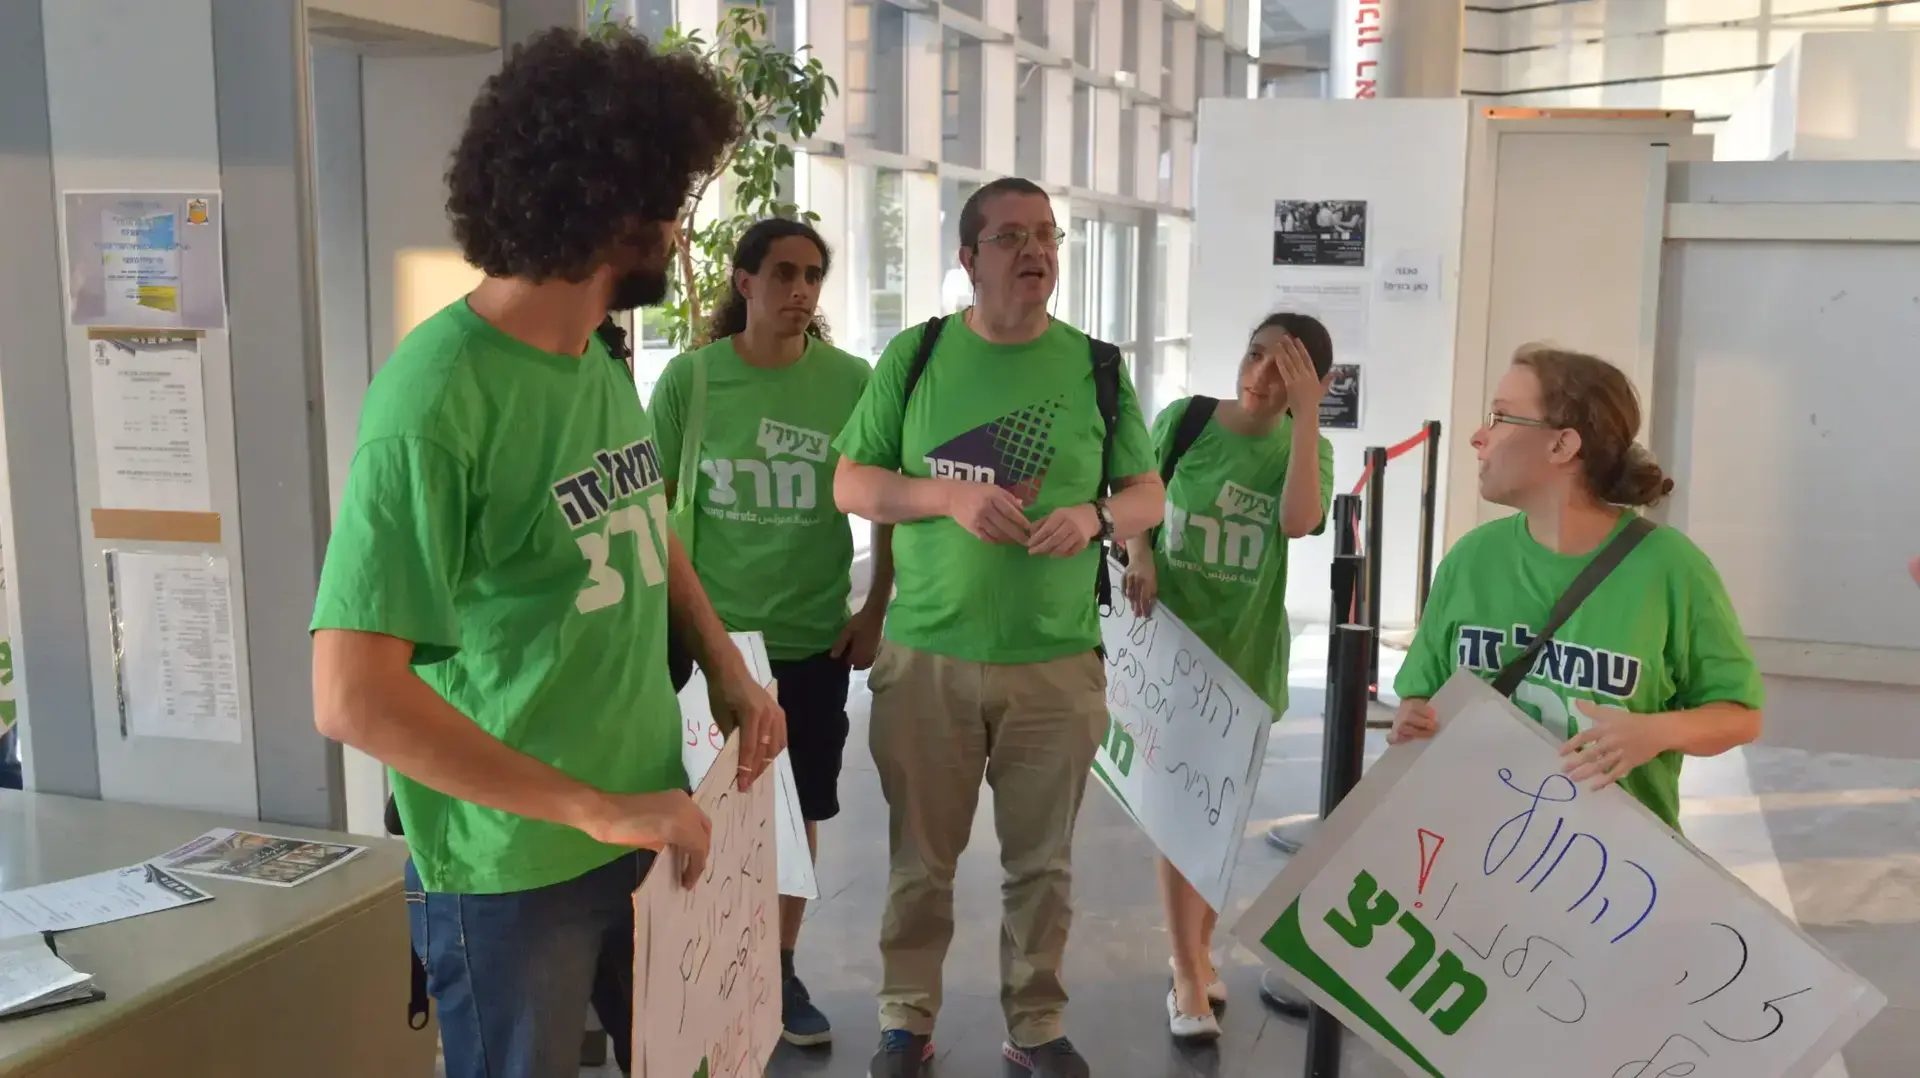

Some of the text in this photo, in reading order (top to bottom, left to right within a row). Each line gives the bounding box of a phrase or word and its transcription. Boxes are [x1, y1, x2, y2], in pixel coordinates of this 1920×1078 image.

[551, 467, 609, 530] זה
[700, 458, 817, 509] מרצ
[1458, 626, 1507, 671] זה
[1322, 869, 1489, 1037] מרצ
